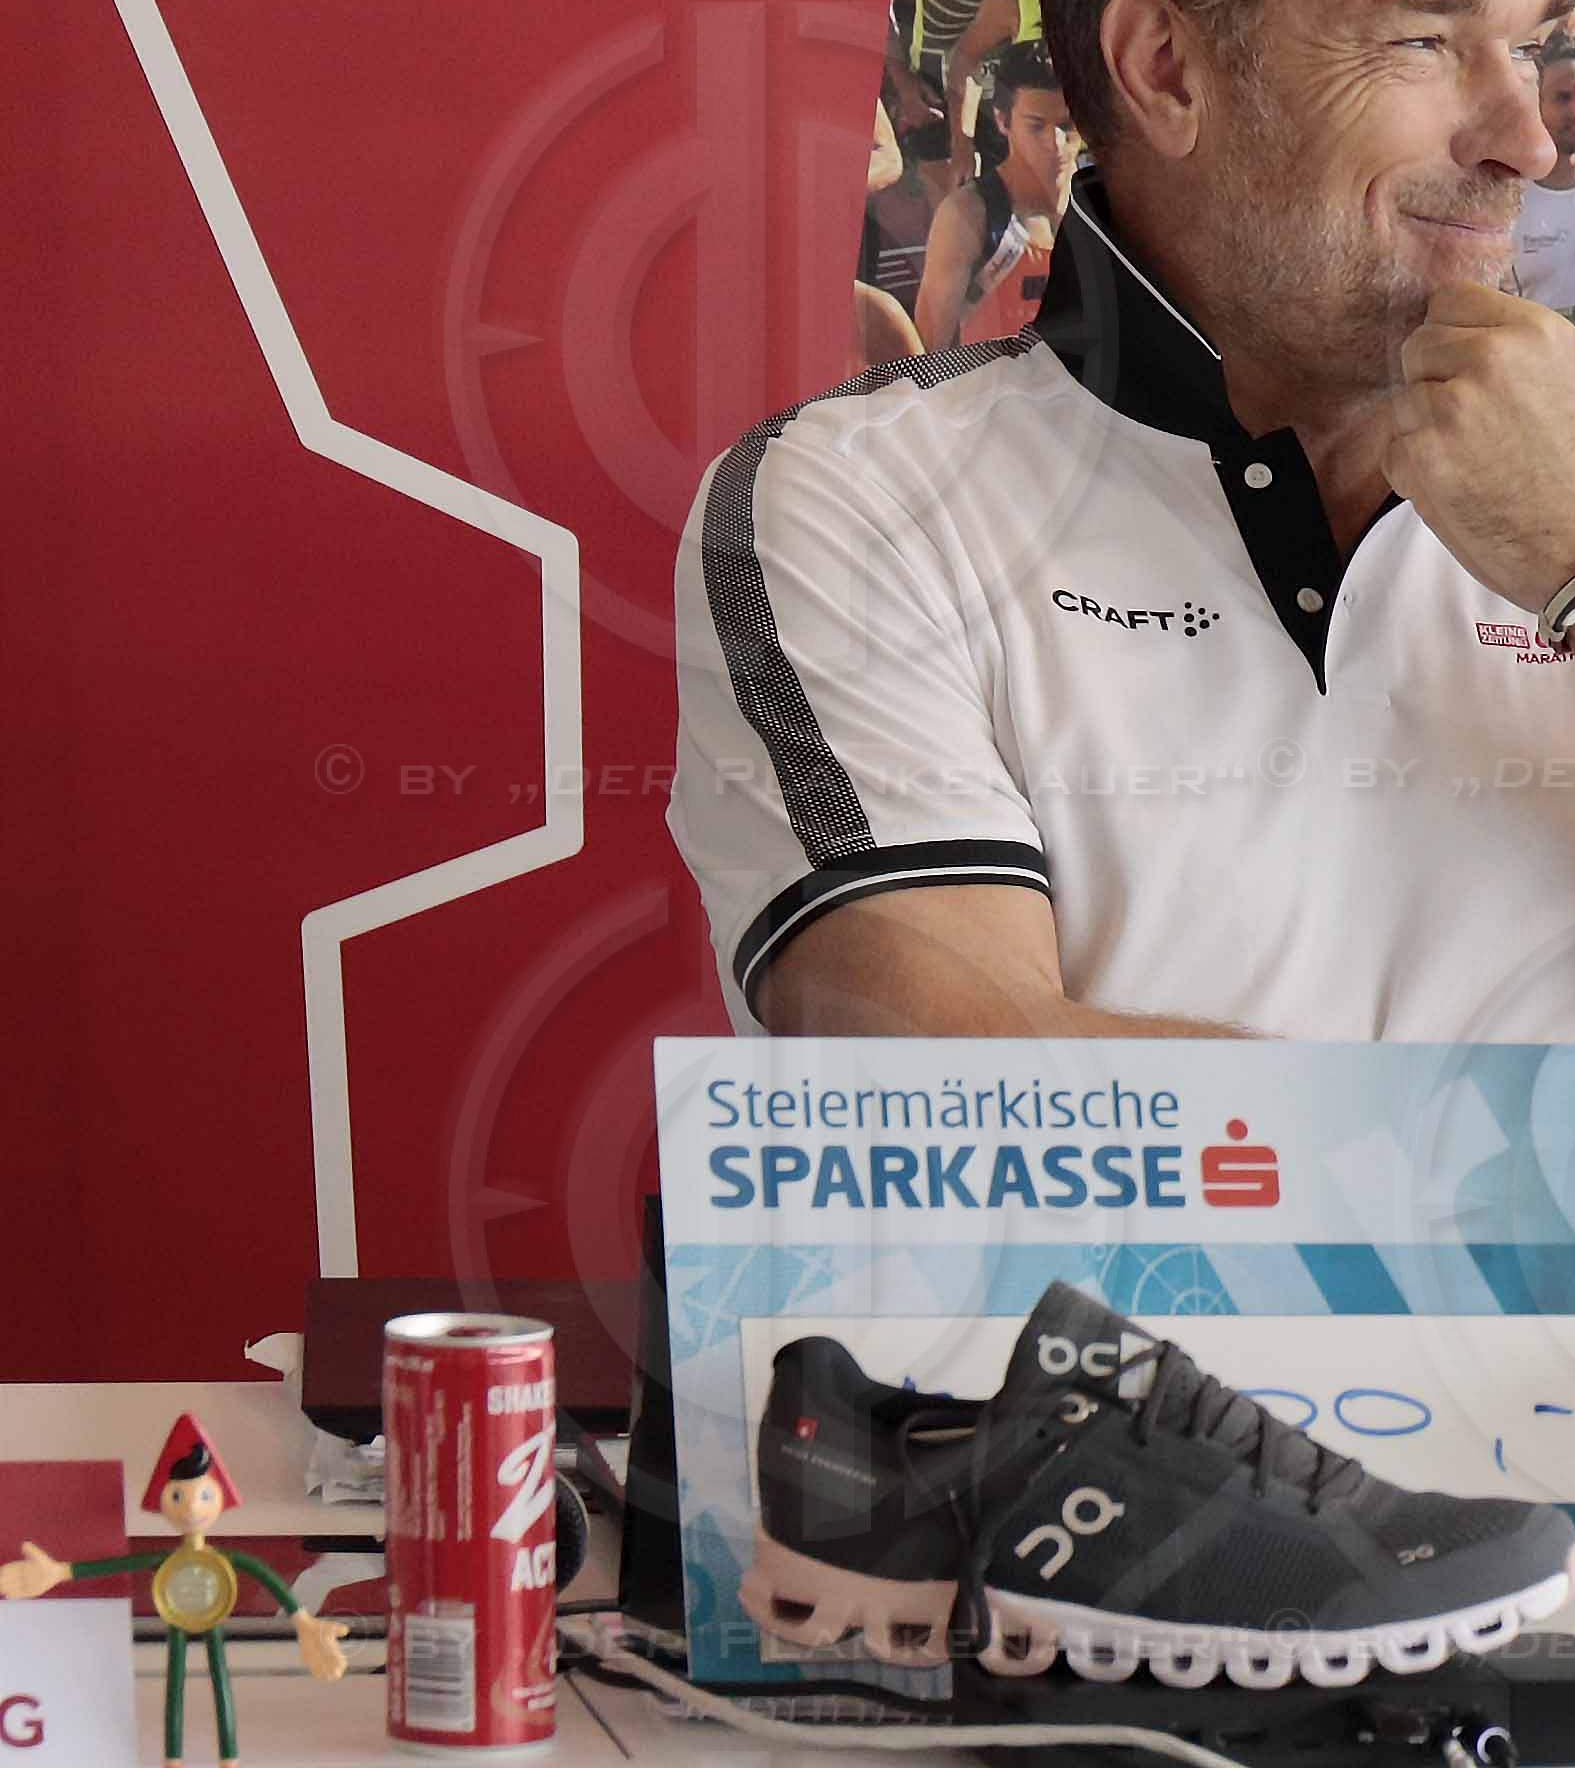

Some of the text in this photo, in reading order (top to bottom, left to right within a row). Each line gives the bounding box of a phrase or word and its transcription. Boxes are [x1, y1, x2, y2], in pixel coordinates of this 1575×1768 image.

[1051, 587, 1175, 633] CRAFT
[706, 1078, 1179, 1131] Steiermärkische
[708, 1143, 1188, 1209] SPARKASSE
